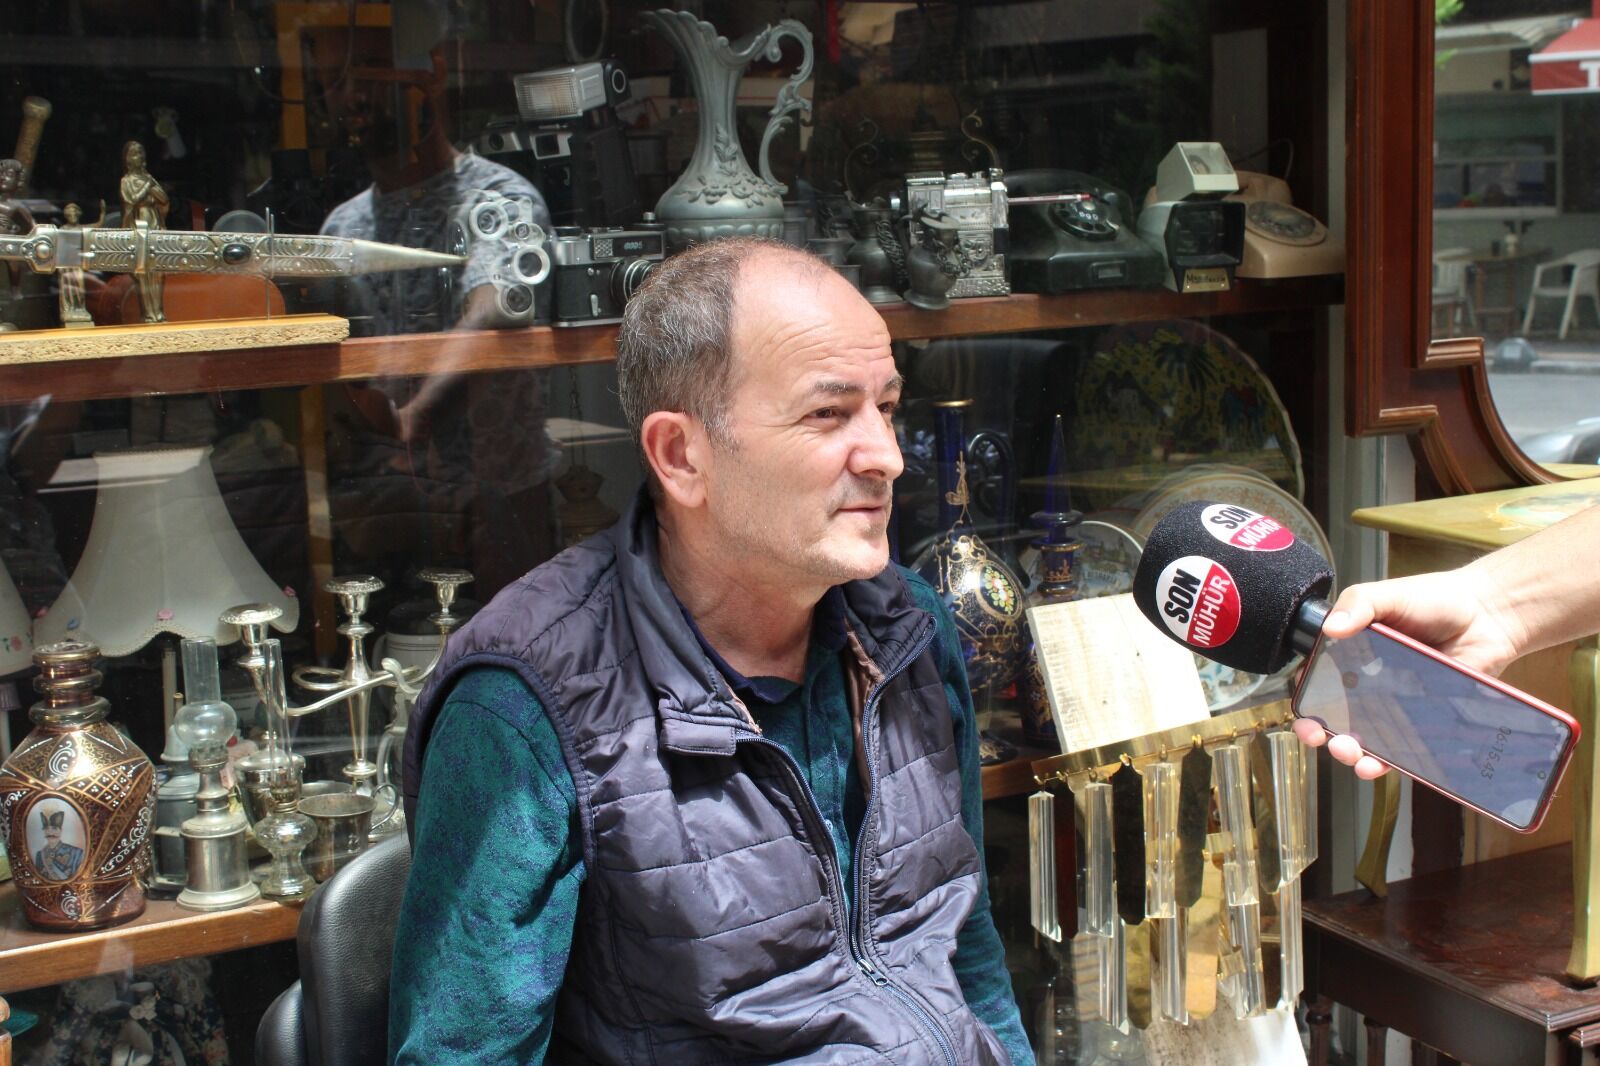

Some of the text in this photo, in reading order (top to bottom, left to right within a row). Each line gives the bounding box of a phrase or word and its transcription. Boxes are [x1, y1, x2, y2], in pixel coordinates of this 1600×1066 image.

[1210, 505, 1254, 530] SON
[1164, 568, 1201, 624] SON
[1193, 574, 1231, 646] MÜHÜR
